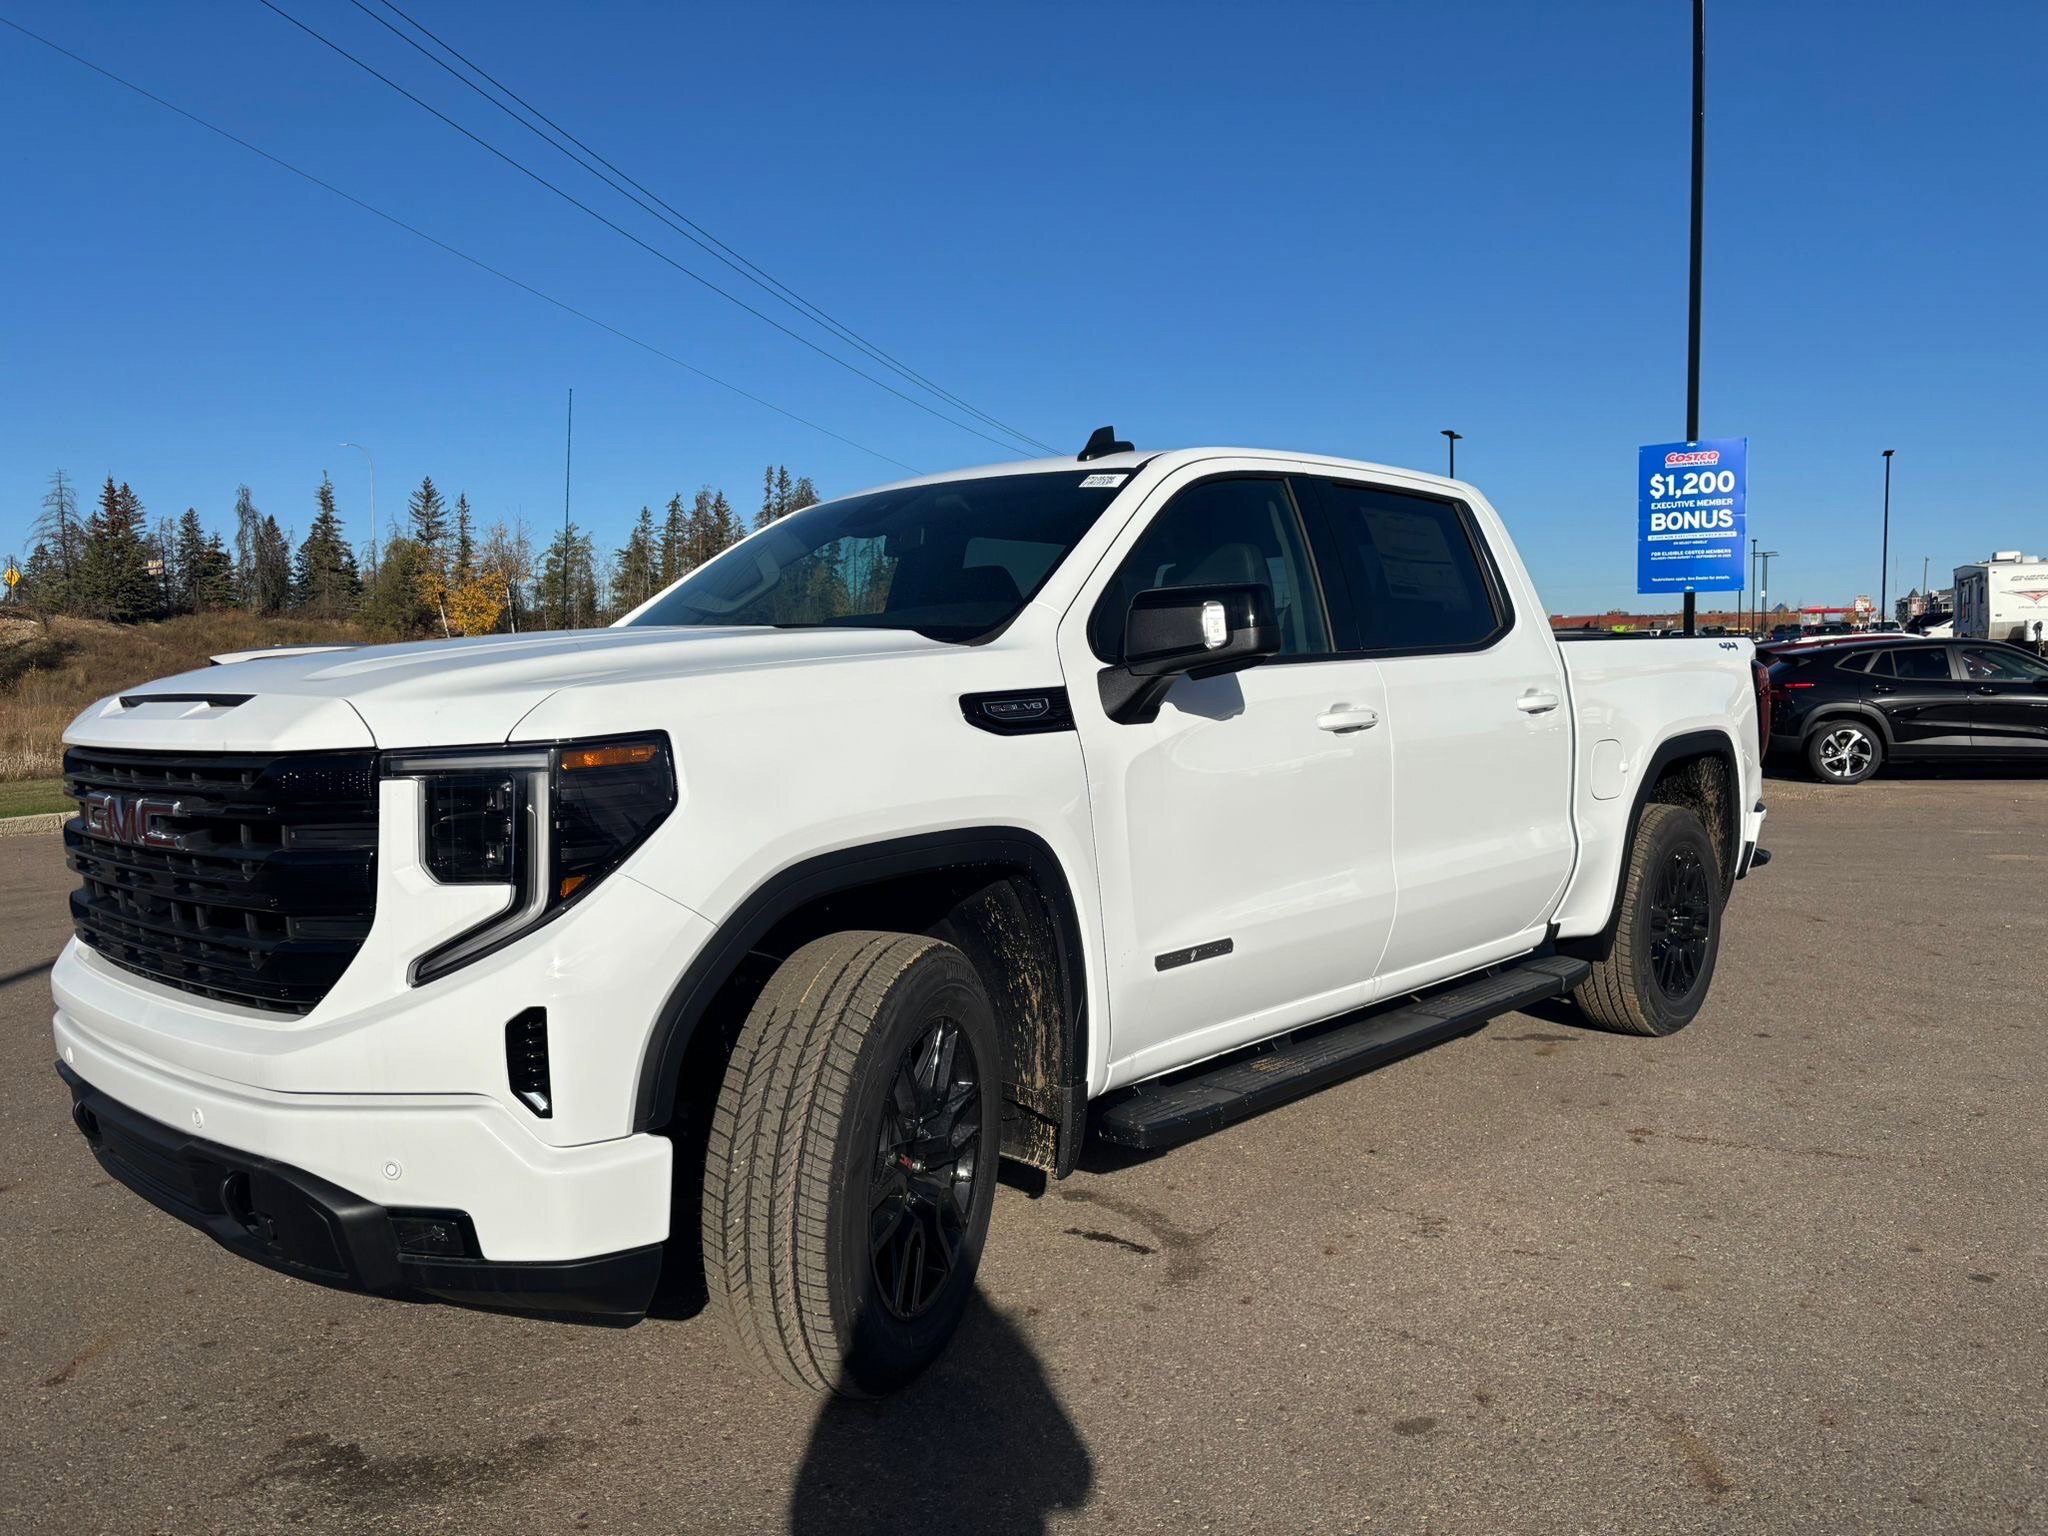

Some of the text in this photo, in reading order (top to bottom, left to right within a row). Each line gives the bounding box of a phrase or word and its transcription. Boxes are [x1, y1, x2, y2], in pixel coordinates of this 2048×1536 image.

[1666, 451, 1719, 463] COSTCO
[1650, 470, 1735, 499] $1,200
[1651, 498, 1733, 510] EXECUTIVE MEMBER
[1651, 509, 1734, 531] BONUS
[1023, 702, 1043, 710] V8
[85, 792, 185, 850] GMC
